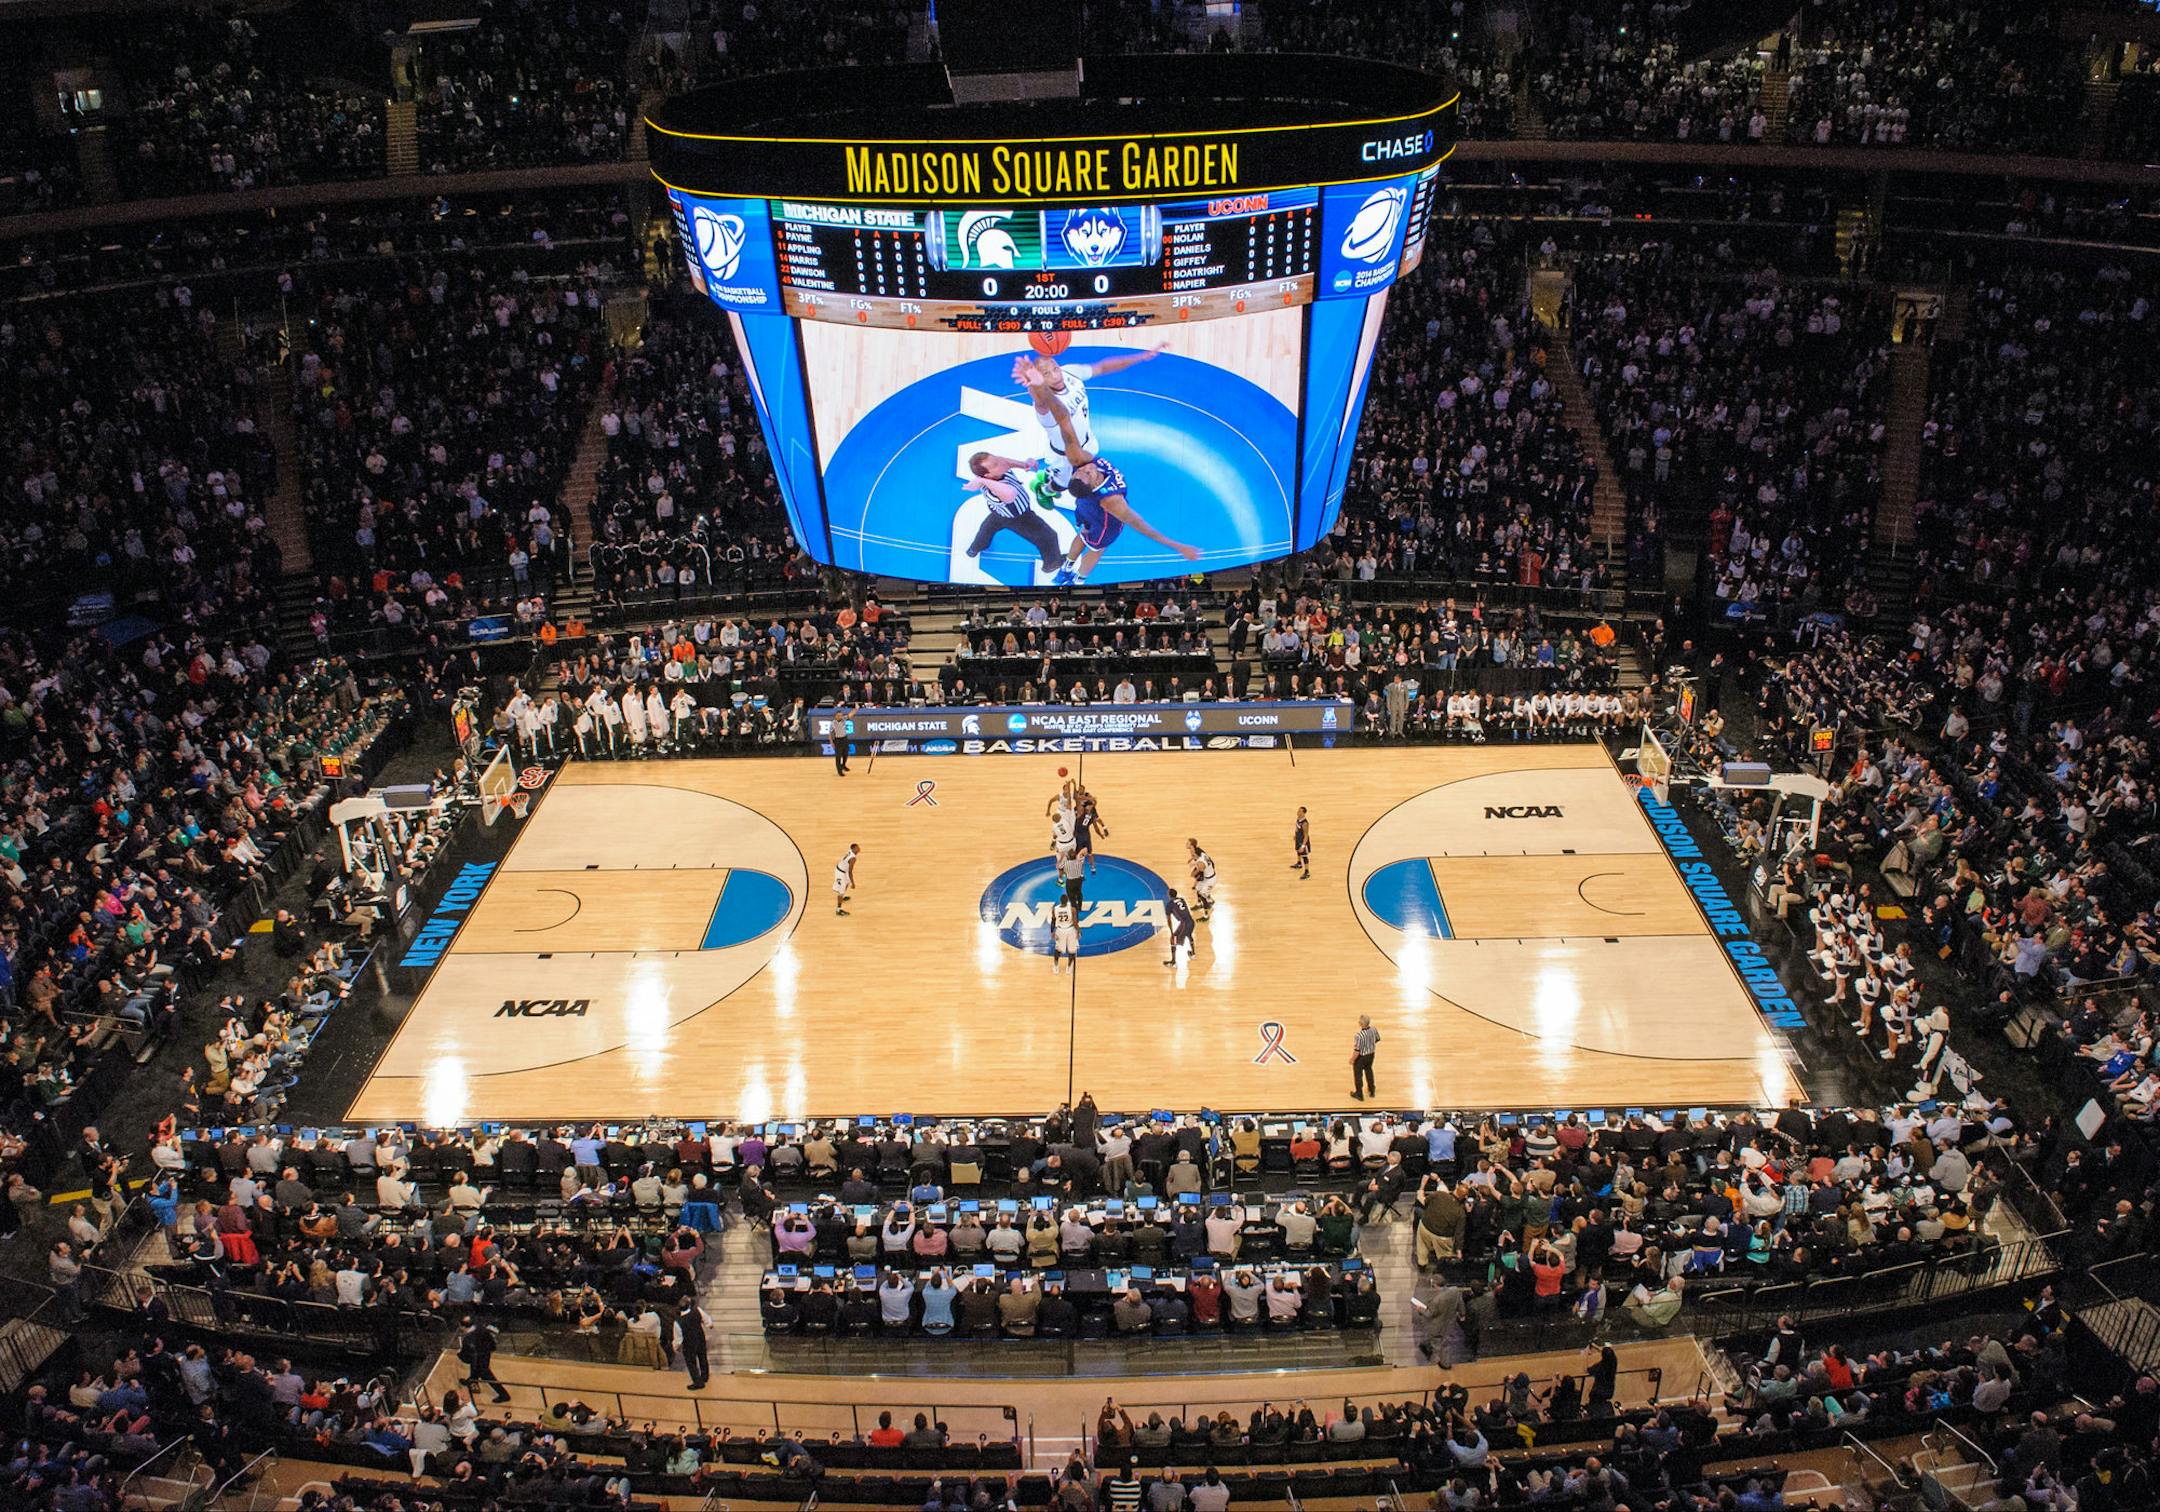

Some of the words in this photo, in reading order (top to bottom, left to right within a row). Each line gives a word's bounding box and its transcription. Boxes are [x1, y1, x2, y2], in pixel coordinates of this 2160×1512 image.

[1362, 134, 1424, 161] CHASE
[845, 146, 981, 193] MADISON
[992, 146, 1111, 197] SQUARE
[1122, 142, 1239, 189] GARDEN
[1208, 194, 1269, 216] UCONN
[782, 201, 861, 225] MICHIGAN
[864, 210, 916, 227] STATE
[784, 222, 812, 233] PLAYER
[1174, 223, 1205, 233] PLAYER
[785, 232, 812, 243] PAYNE
[1162, 235, 1173, 245] 00
[1173, 233, 1204, 244] NOLAN
[787, 243, 822, 255] APPLING
[1164, 247, 1171, 256] 2
[1173, 243, 1212, 256] DANIELS
[779, 254, 789, 262] 14
[788, 254, 818, 266] HARRIS
[1173, 255, 1207, 267] GIFFEY
[780, 264, 790, 273] 22
[790, 266, 826, 278] DAWSON
[1035, 273, 1055, 283] 1ST
[1162, 271, 1173, 279] 11
[1173, 264, 1225, 277] BOATRIGHT
[792, 277, 835, 290] VALENTINE
[983, 278, 998, 296] 0
[1094, 275, 1109, 293] 0
[1162, 281, 1173, 290] 13
[1173, 278, 1206, 290] NAPIER
[1025, 284, 1068, 299] 20:00
[1172, 296, 1201, 307] 3PT%
[1230, 289, 1252, 300] FG%
[1279, 281, 1298, 293] FT%
[798, 292, 824, 305] 3PT%
[850, 300, 873, 310] FG%
[900, 303, 921, 313] FT%
[1010, 307, 1018, 316] 0
[1032, 306, 1060, 315] FOULS
[1076, 305, 1083, 314] 0
[957, 321, 981, 330] FULL:
[985, 321, 992, 330] 1
[1024, 321, 1032, 330] 4
[1041, 321, 1053, 330] TO
[1062, 319, 1087, 329] FULL:
[1091, 319, 1097, 328] 1
[1128, 316, 1136, 326] 4
[867, 721, 916, 732] MICHIGAN
[917, 720, 948, 730] STATE
[1031, 716, 1066, 726] NCAA
[1069, 715, 1098, 724] EAST
[1103, 713, 1162, 724] REGIONAL
[1239, 715, 1279, 725] UCONN
[963, 736, 1203, 754] BASKETBALL
[1484, 805, 1564, 819] NCAA
[400, 918, 461, 967] NEW
[433, 861, 498, 914] YORK
[1679, 861, 1750, 936] SQUARE
[1725, 940, 1809, 1028] GARDEN
[493, 999, 591, 1018] NCAA
